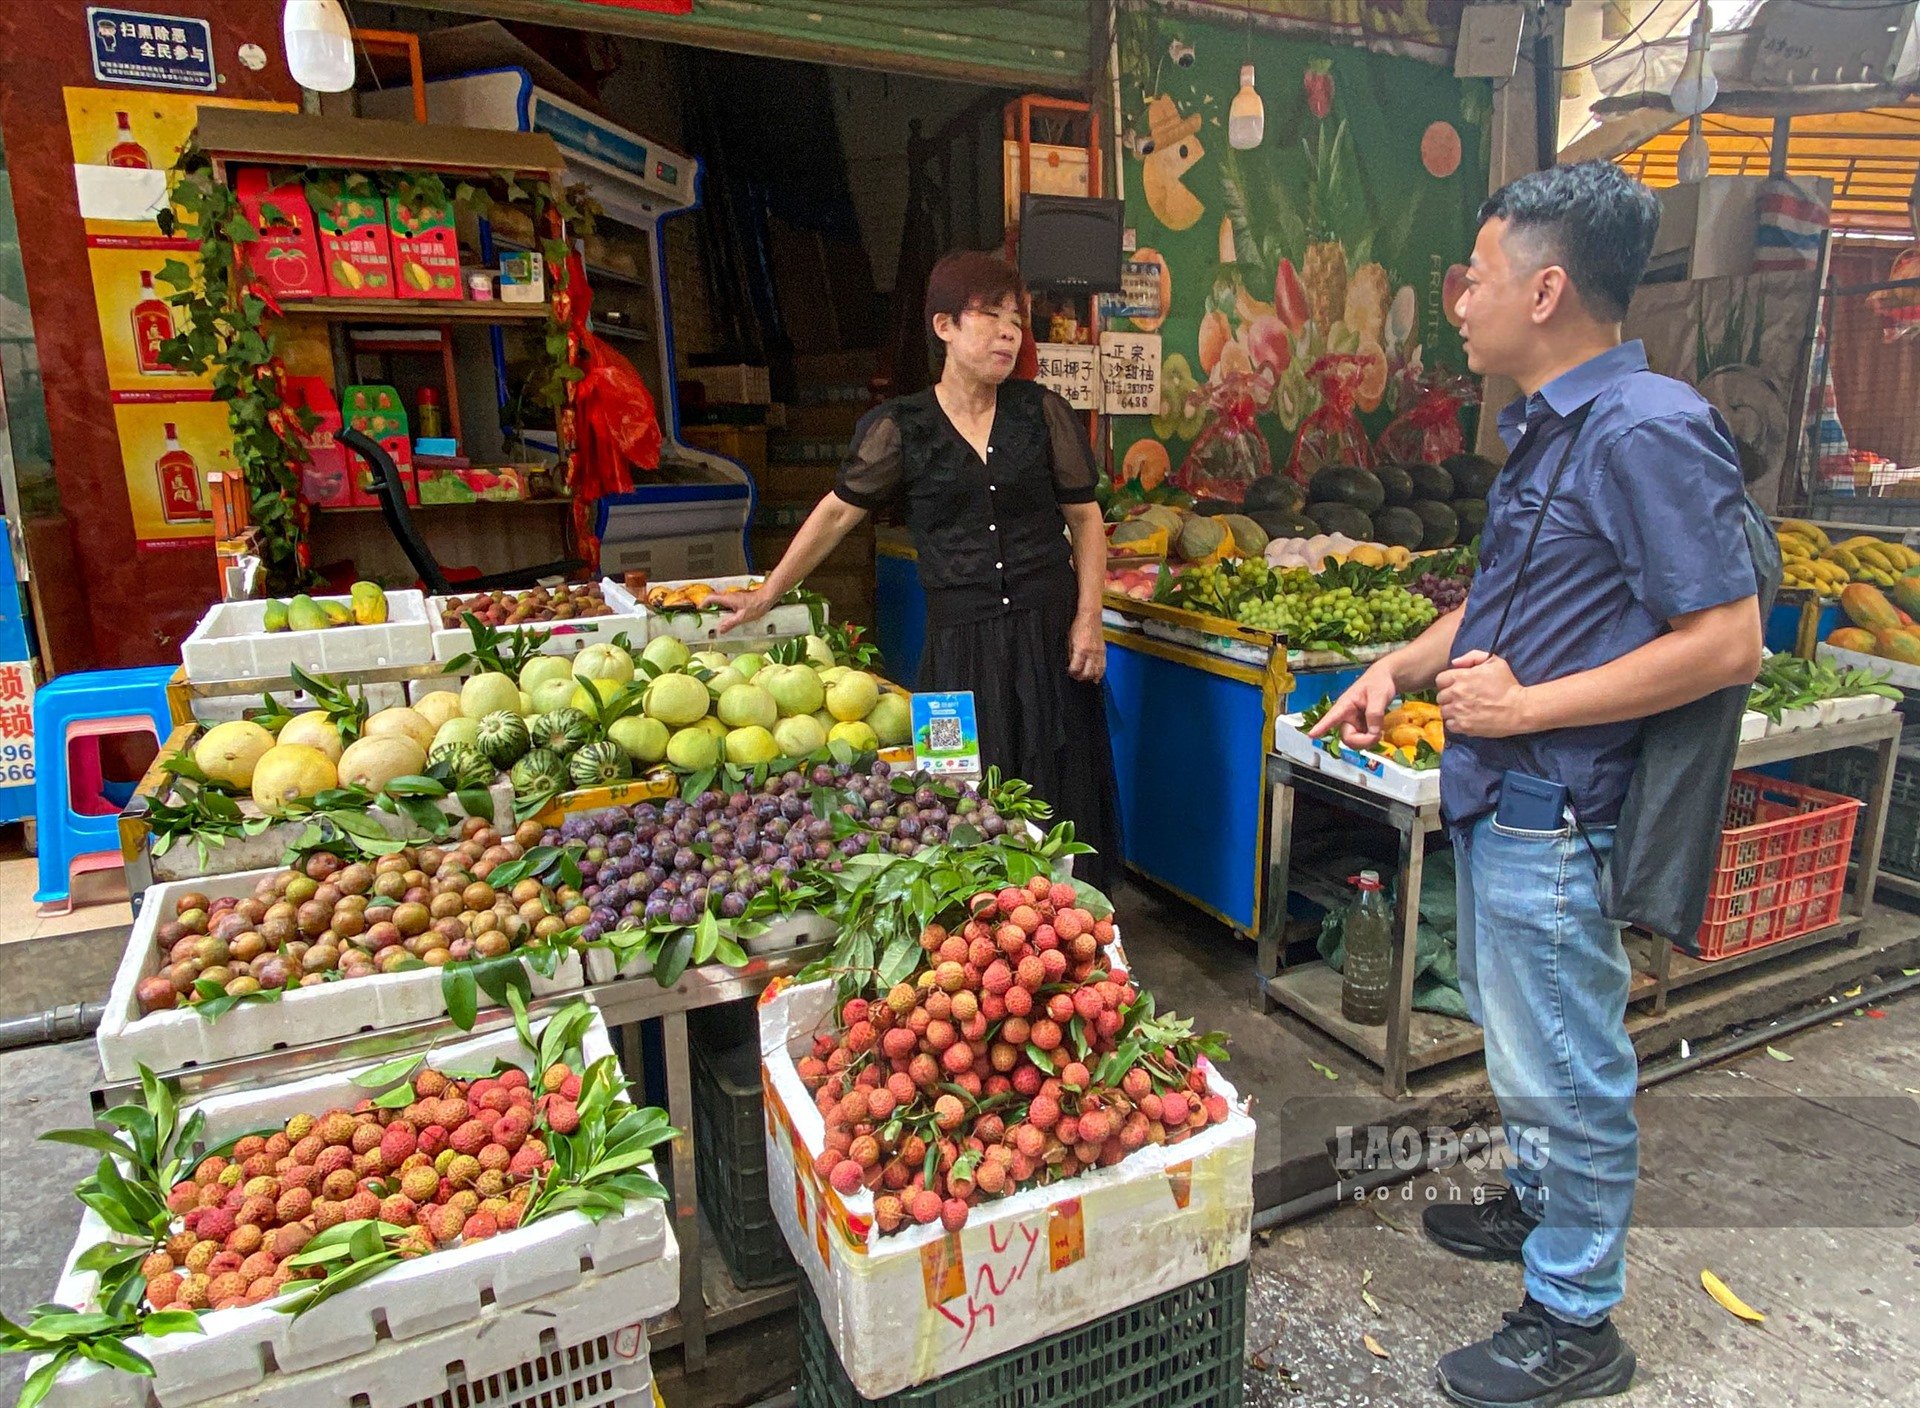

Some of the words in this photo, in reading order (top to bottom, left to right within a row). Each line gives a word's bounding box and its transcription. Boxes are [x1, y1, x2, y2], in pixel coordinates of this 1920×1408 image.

[120, 21, 187, 43] 扫黑除恶
[140, 41, 204, 62] 全民参与
[1427, 254, 1441, 349] FRUITS
[1110, 344, 1146, 361] 正宗
[1037, 356, 1094, 381] 泰国椰子
[1108, 363, 1155, 381] 沙甜柚
[0, 743, 32, 761] 96
